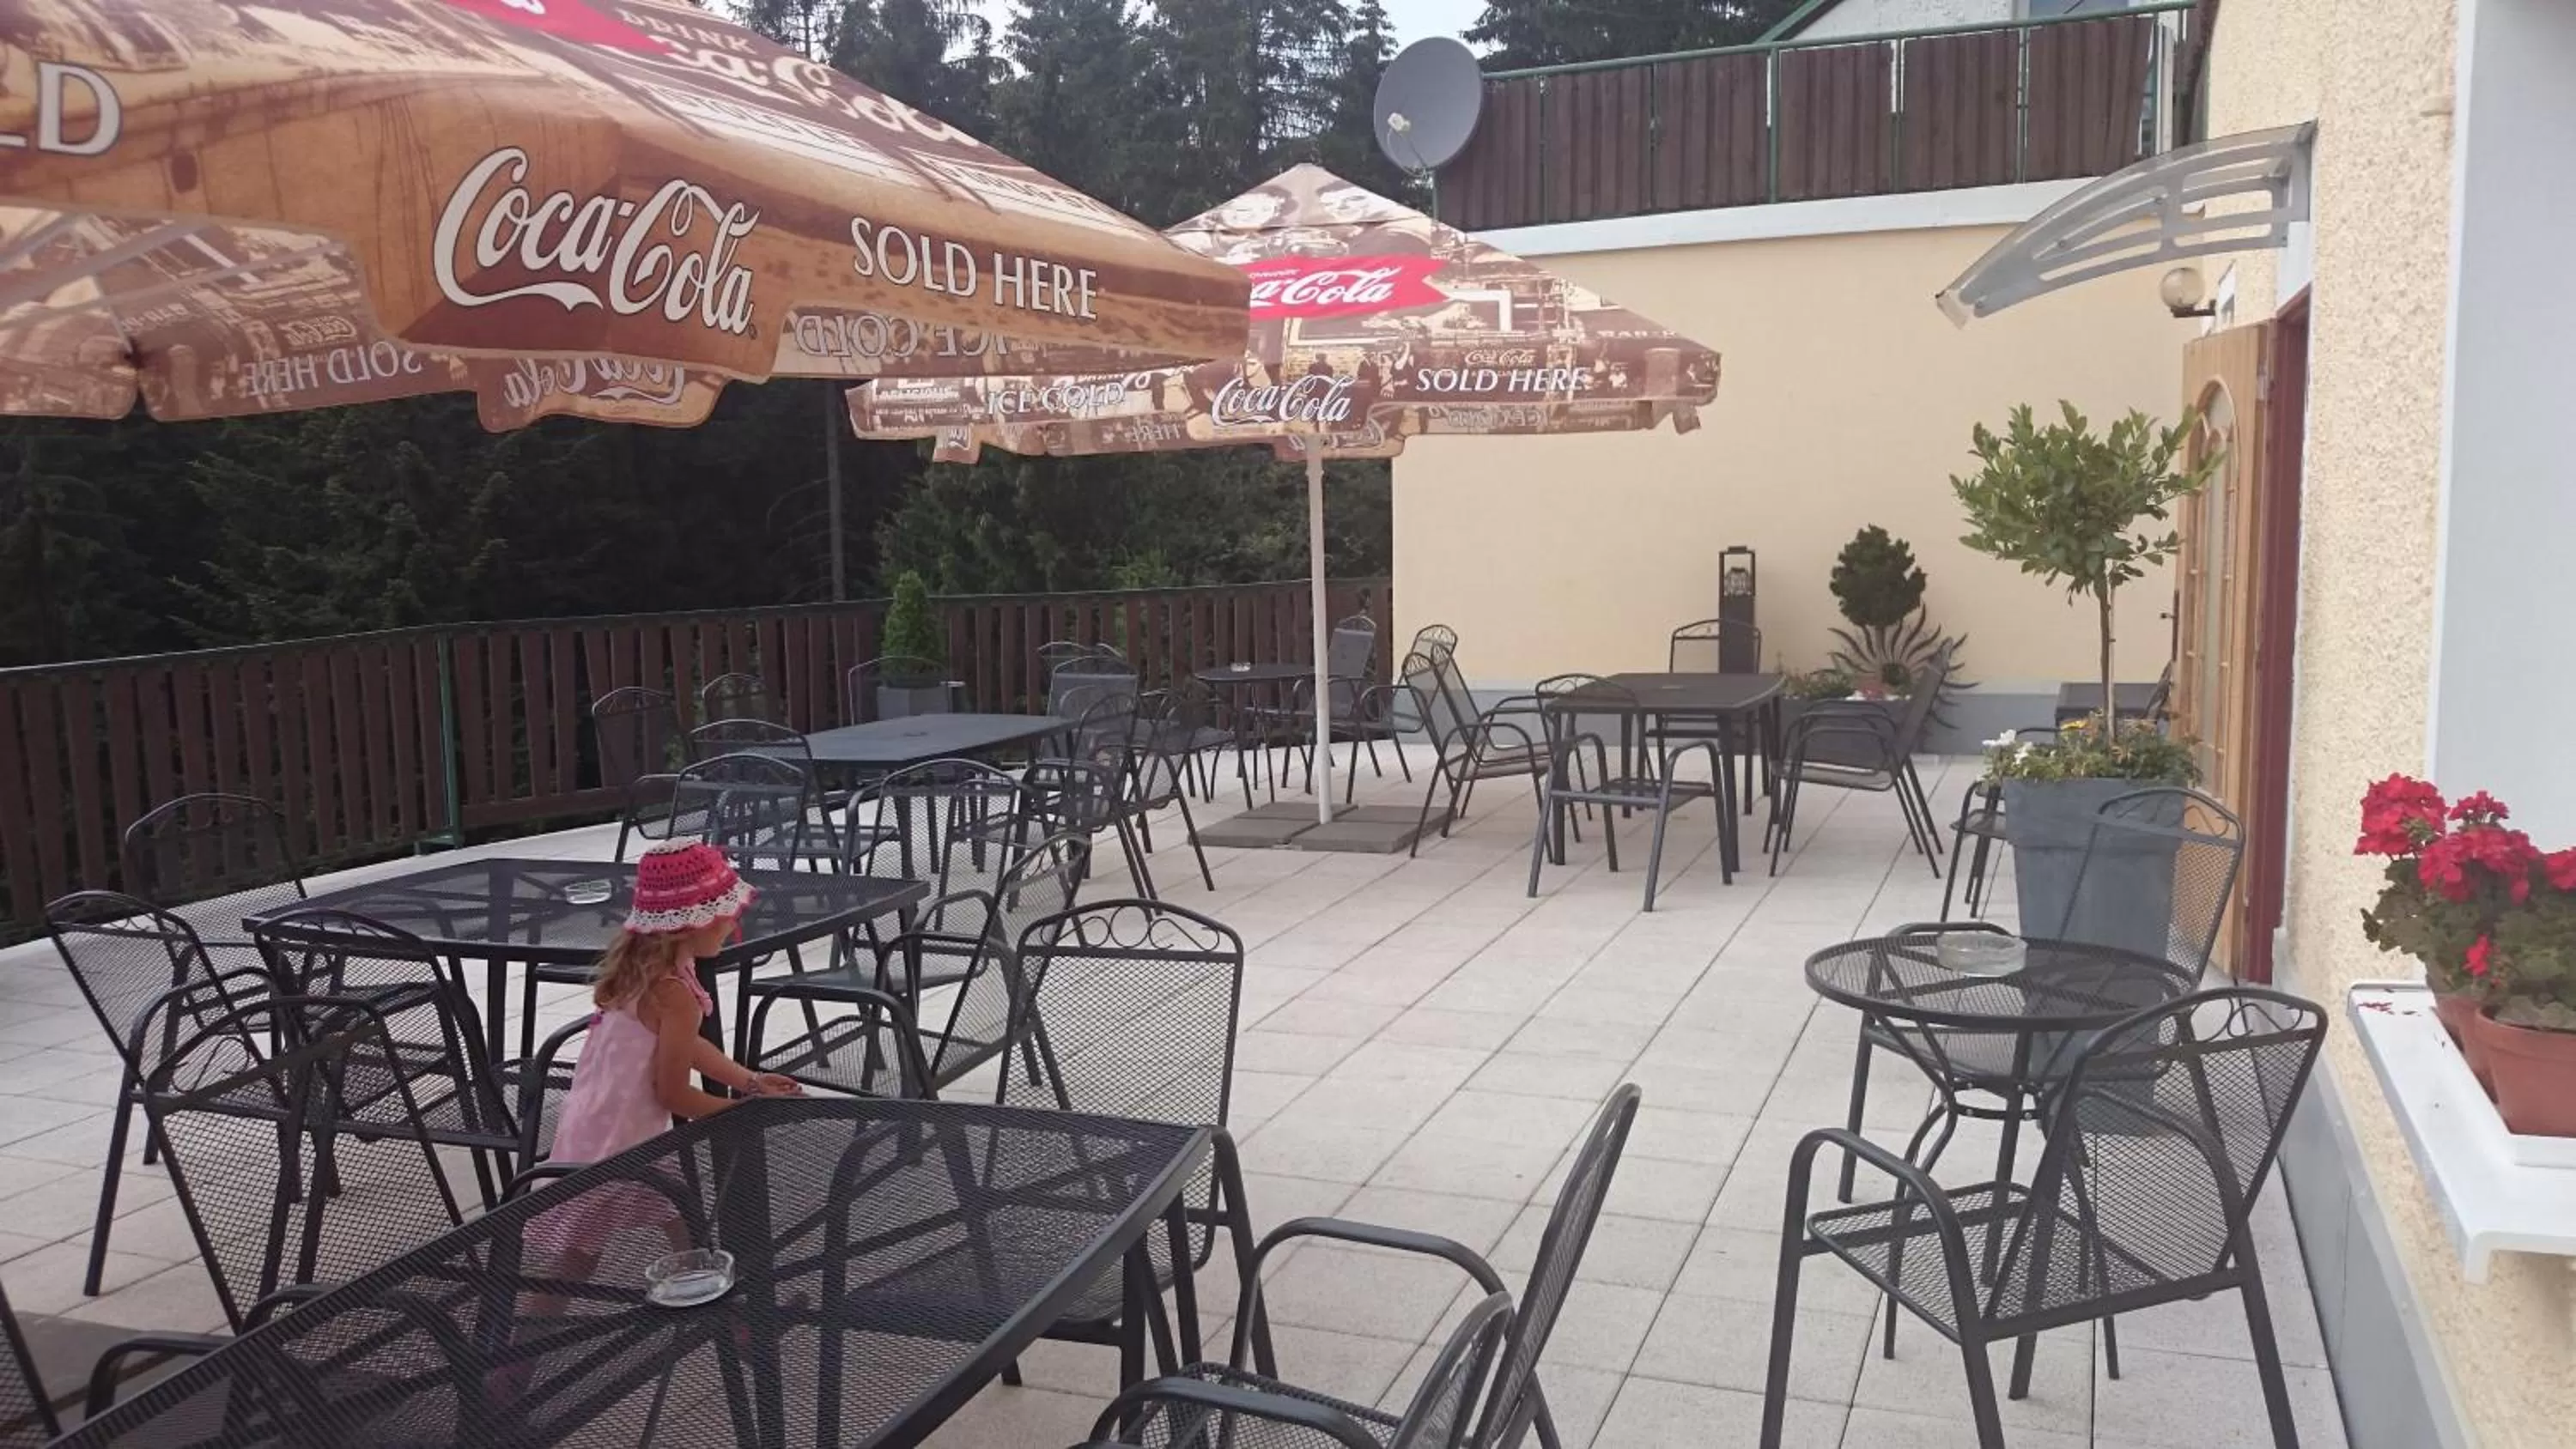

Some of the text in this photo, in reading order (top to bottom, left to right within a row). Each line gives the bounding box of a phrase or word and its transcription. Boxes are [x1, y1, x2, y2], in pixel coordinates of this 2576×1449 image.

[433, 146, 762, 336] Coca-Cola
[850, 215, 1099, 321] SOLD HERE
[987, 390, 1036, 415] ICE
[1041, 383, 1126, 413] COLD
[1211, 373, 1360, 427] Coca-Cola
[1415, 367, 1590, 392] SOLD HERE
